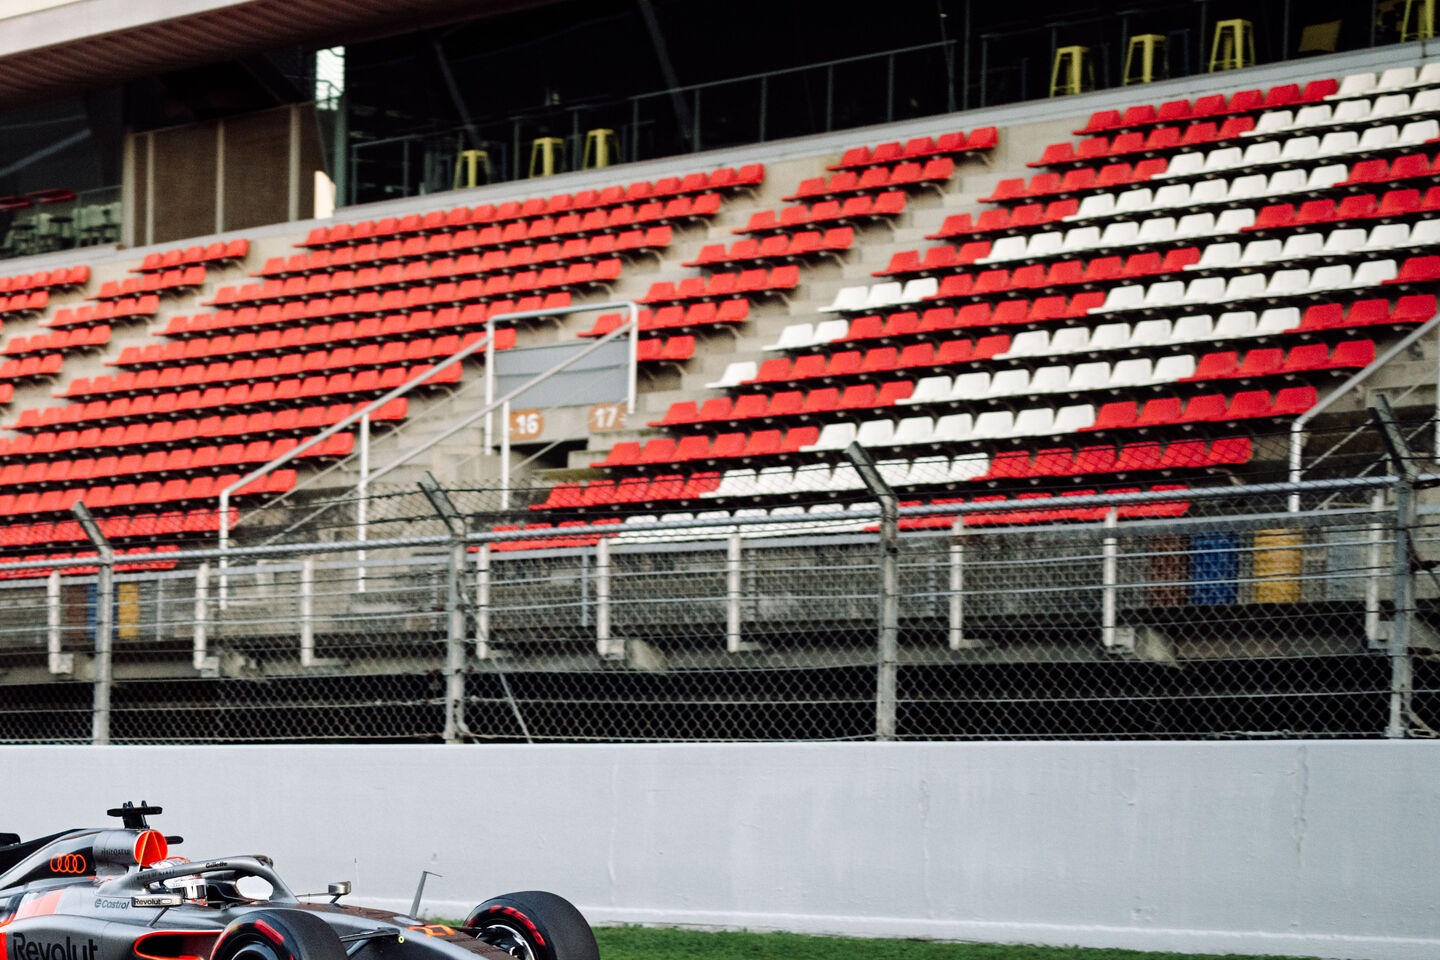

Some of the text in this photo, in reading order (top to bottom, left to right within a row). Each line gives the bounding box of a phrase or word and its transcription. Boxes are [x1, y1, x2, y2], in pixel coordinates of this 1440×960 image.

[516, 413, 540, 435] 16
[594, 406, 618, 428] 17
[101, 899, 130, 910] Castrol
[134, 898, 161, 906] Revolut
